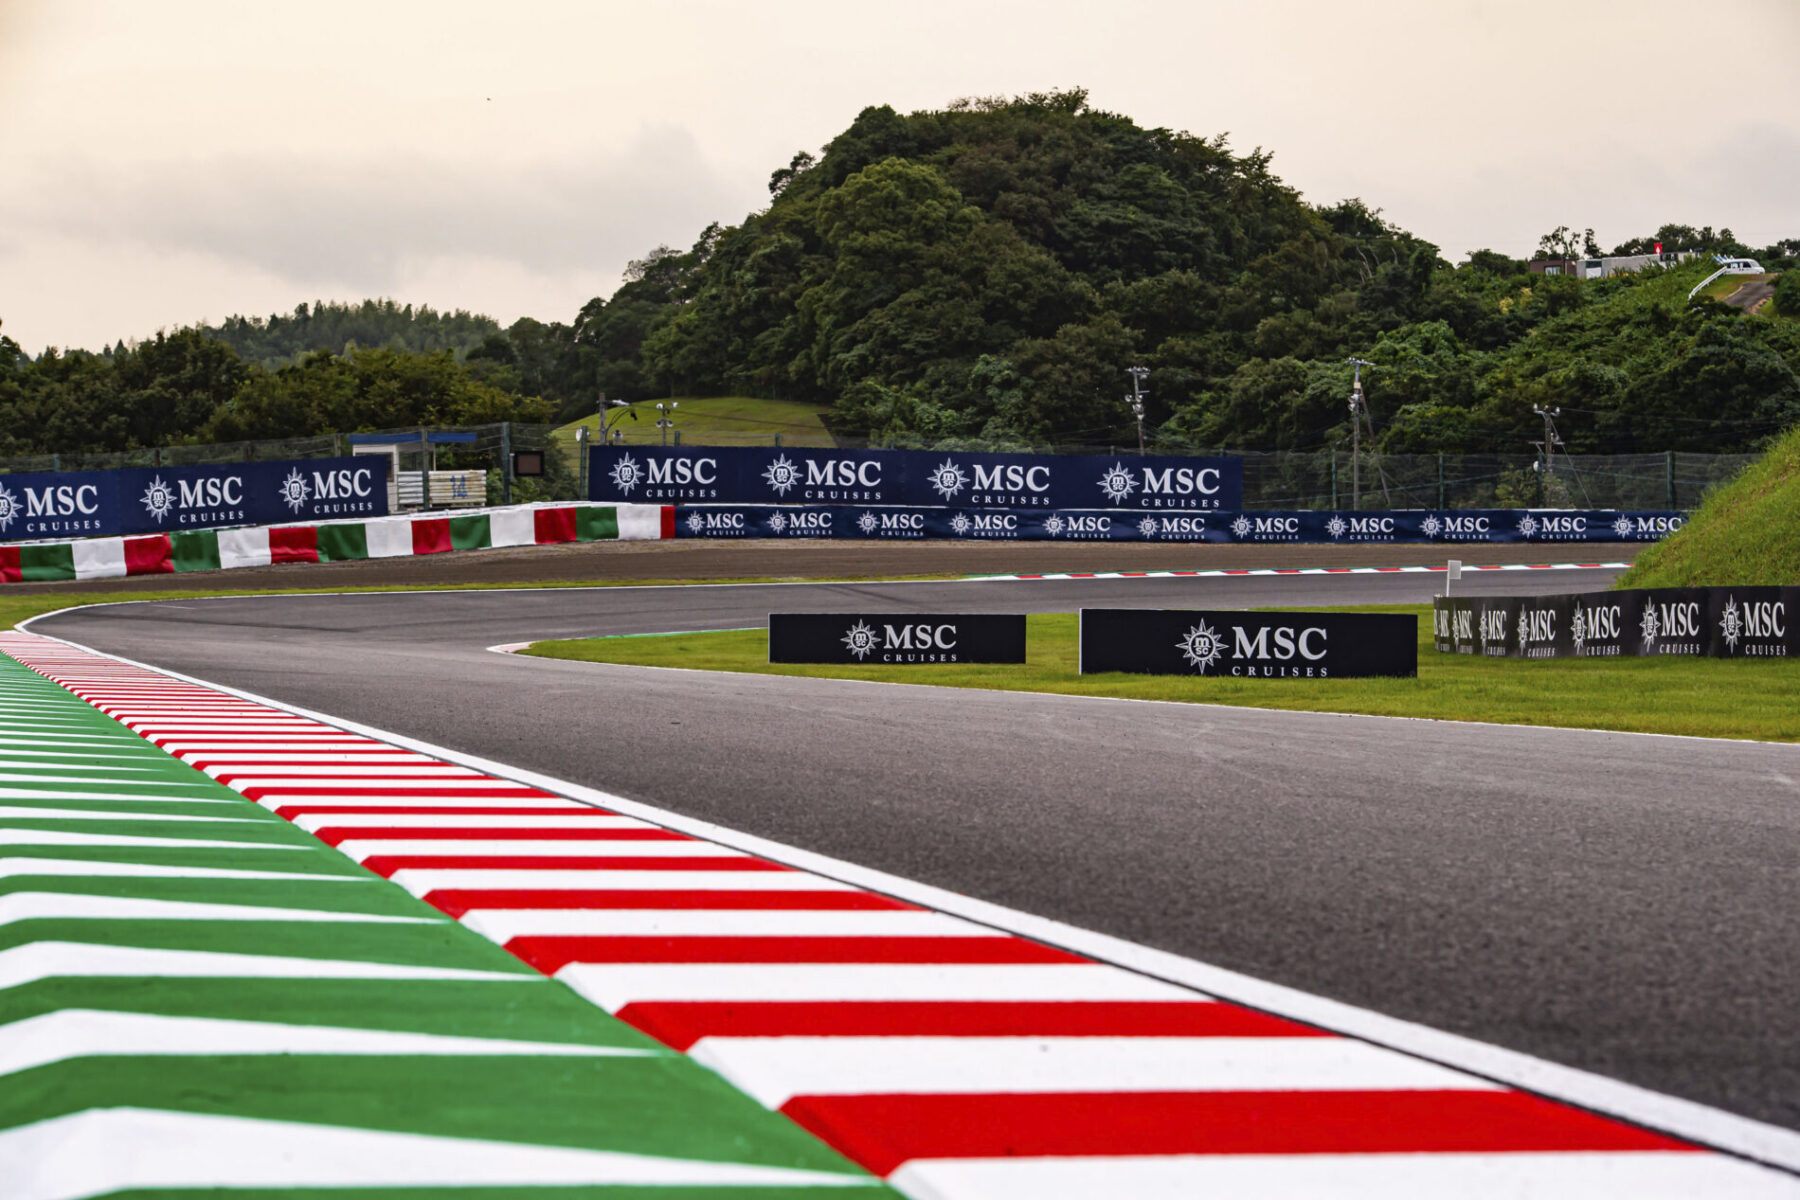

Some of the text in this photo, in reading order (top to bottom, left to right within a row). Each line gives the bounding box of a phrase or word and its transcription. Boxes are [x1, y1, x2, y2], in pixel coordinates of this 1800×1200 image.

[647, 458, 716, 484] MSC
[806, 460, 881, 486] MSC
[973, 465, 1049, 491] MSC
[313, 469, 371, 499] MSC
[1142, 468, 1219, 494] MSC
[178, 477, 242, 508] MSC
[645, 488, 717, 498] CRUISES
[804, 490, 881, 500] CRUISES
[24, 485, 98, 516] MSC
[971, 494, 1050, 506] CRUISES
[1141, 498, 1220, 508] CRUISES
[313, 501, 373, 514] CRUISES
[179, 510, 245, 524] CRUISES
[707, 514, 743, 528] MSC
[790, 513, 831, 527] MSC
[882, 514, 923, 528] MSC
[974, 515, 1016, 529] MSC
[1067, 517, 1110, 531] MSC
[26, 519, 101, 533] CRUISES
[1162, 518, 1204, 532] MSC
[1256, 518, 1298, 532] MSC
[1351, 518, 1393, 532] MSC
[1445, 517, 1488, 532] MSC
[1542, 517, 1586, 532] MSC
[1637, 517, 1681, 532] MSC
[1488, 610, 1506, 640] MSC
[1530, 610, 1555, 641] MSC
[1586, 606, 1620, 639] MSC
[1660, 603, 1699, 636] MSC
[1742, 602, 1784, 637] MSC
[884, 625, 956, 649] MSC
[1232, 627, 1326, 660] MSC
[1586, 644, 1621, 657] CRUISES
[1658, 643, 1700, 655] CRUISES
[1745, 644, 1786, 656] CRUISES
[883, 653, 957, 662] CRUISES
[1231, 665, 1328, 678] CRUISES
